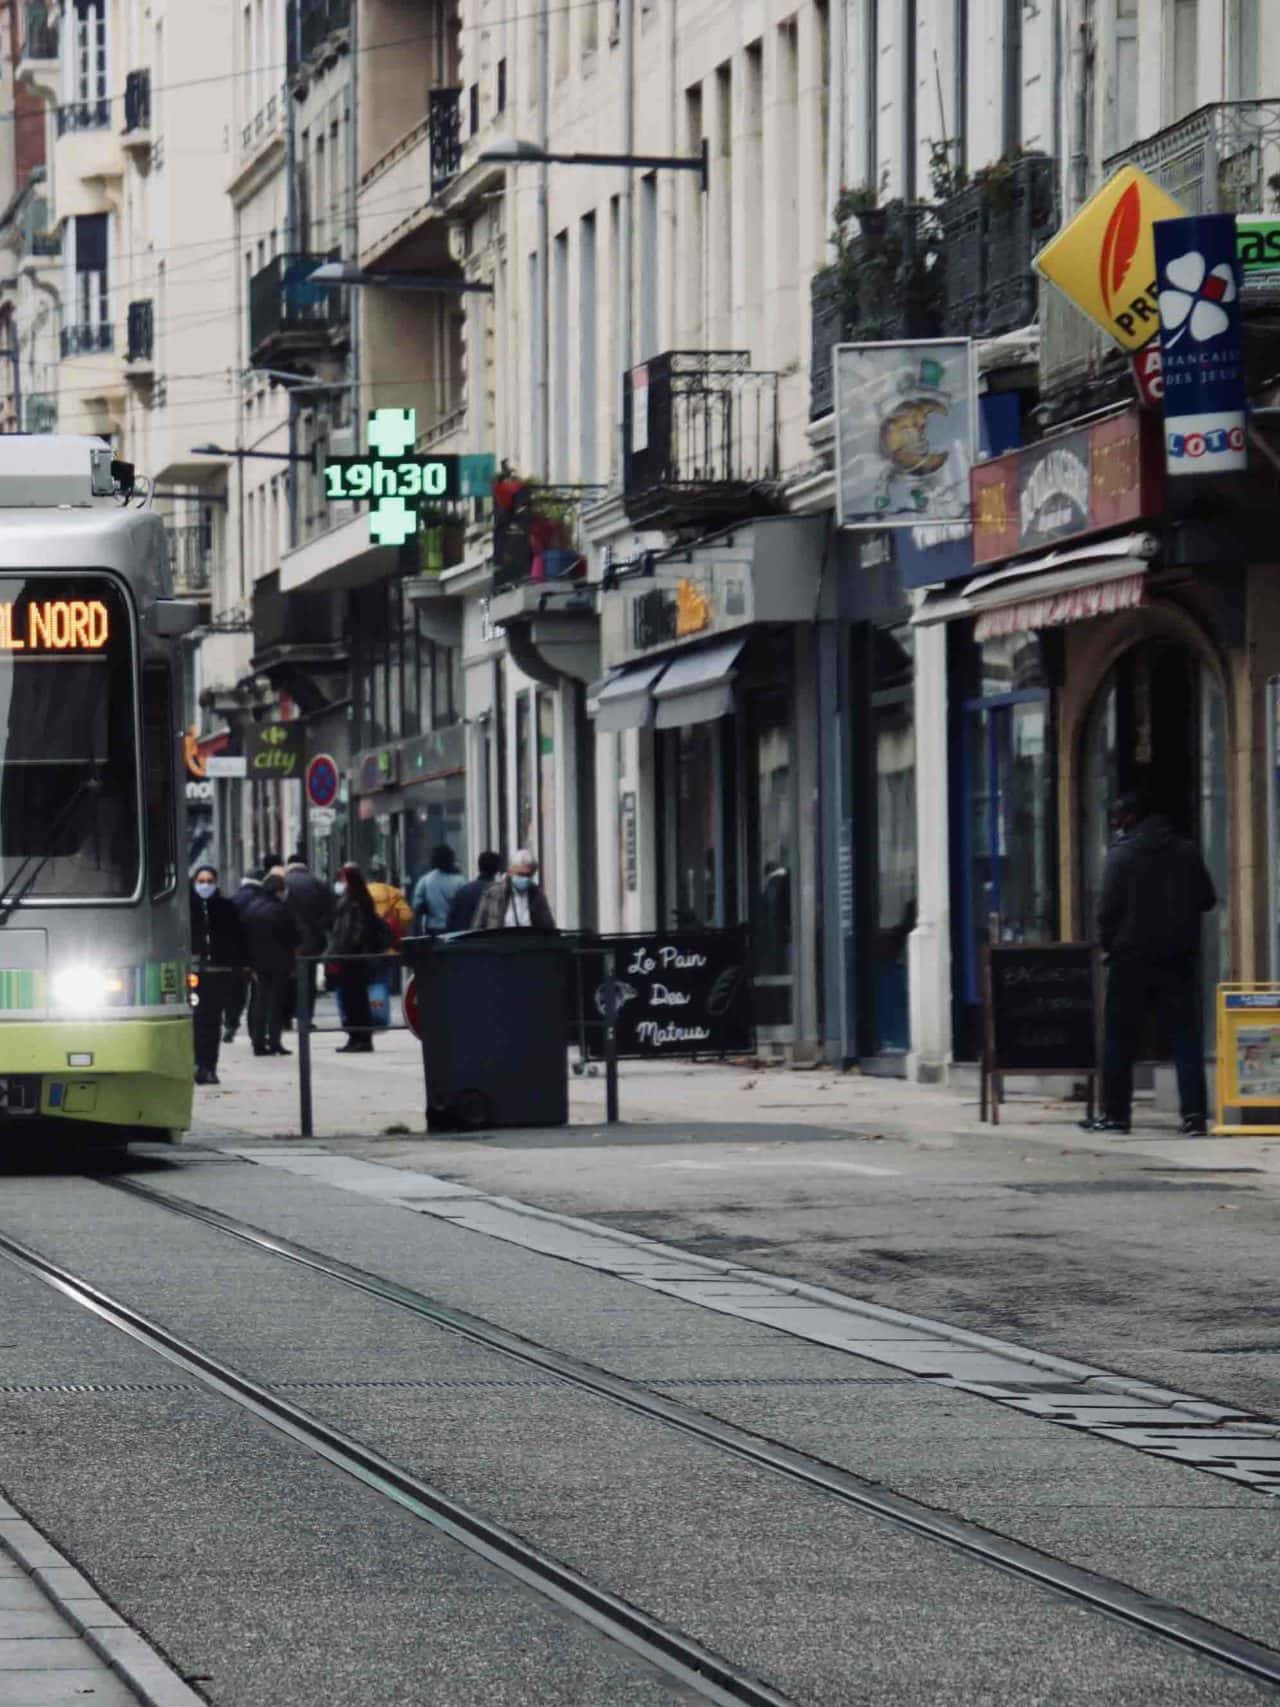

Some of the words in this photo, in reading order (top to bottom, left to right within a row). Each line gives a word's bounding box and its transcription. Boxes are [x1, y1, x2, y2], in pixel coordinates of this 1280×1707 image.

[1169, 428, 1245, 457] LOTO
[324, 461, 446, 496] 19h30
[29, 601, 108, 649] NORD
[254, 750, 296, 775] city
[628, 947, 656, 974] Le
[658, 946, 706, 968] Pain
[649, 983, 691, 1005] Des
